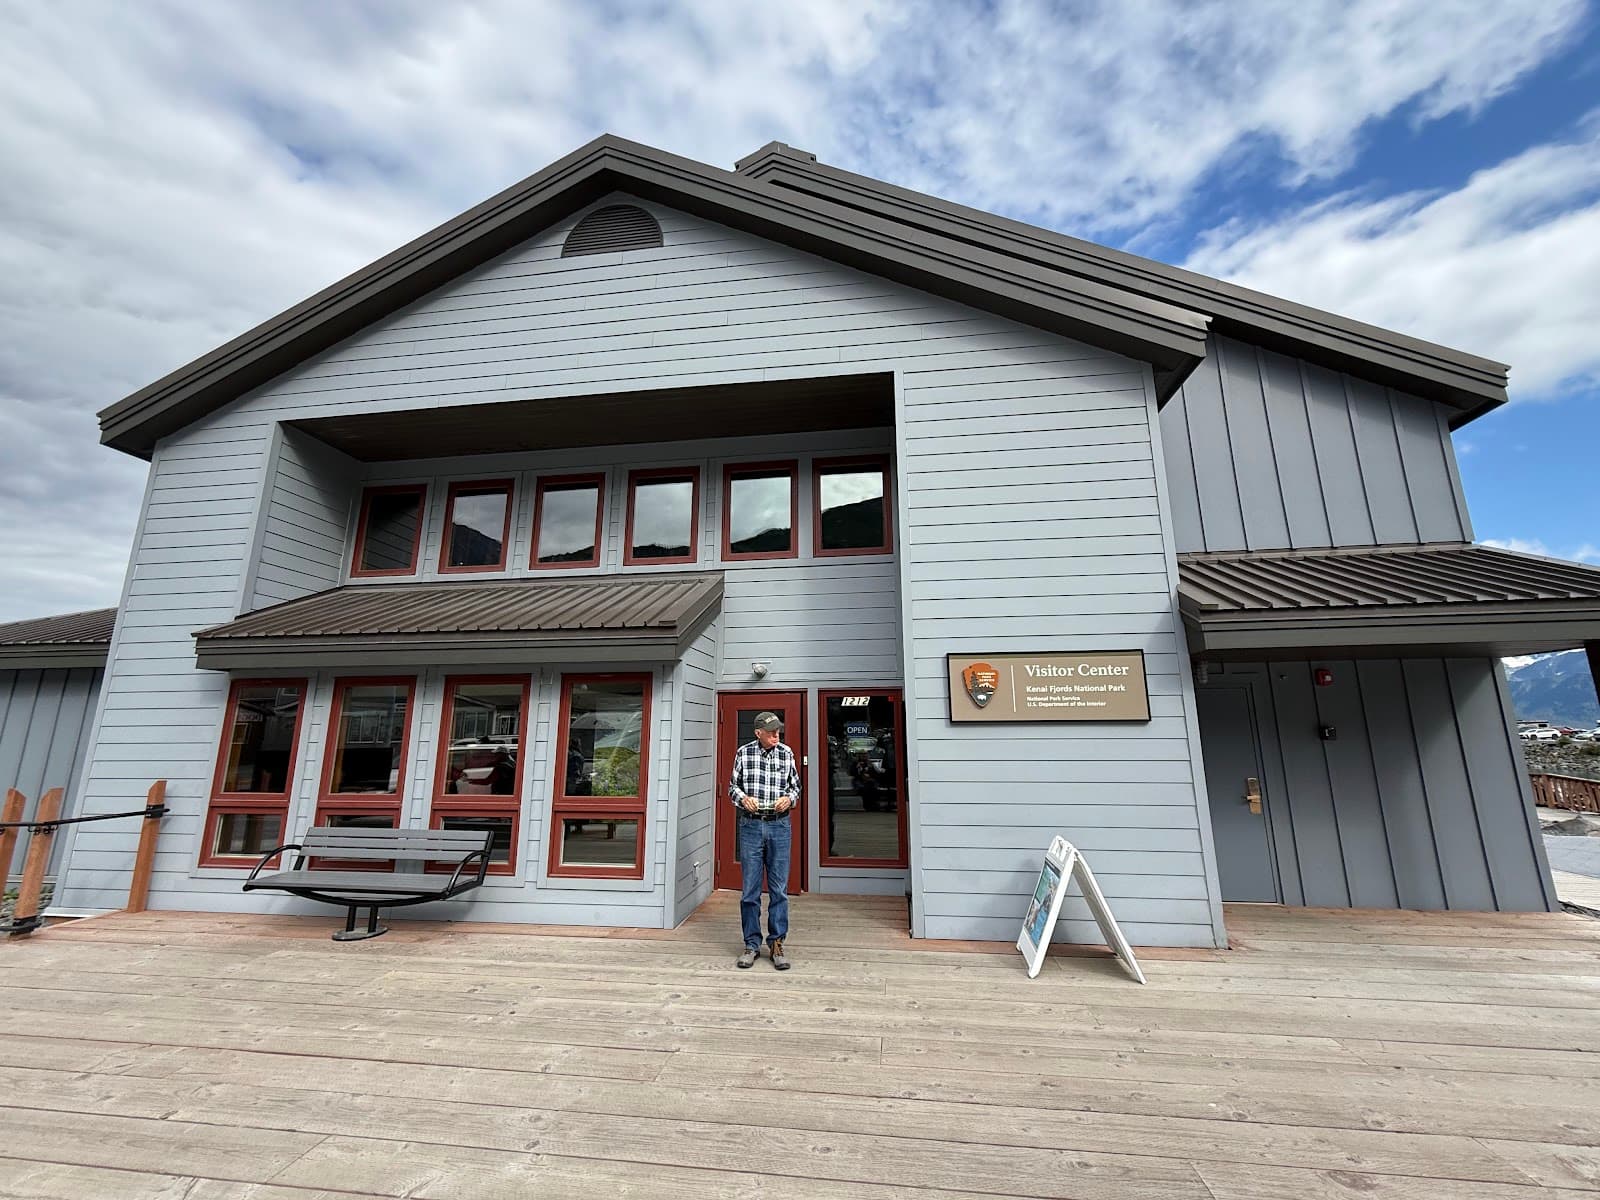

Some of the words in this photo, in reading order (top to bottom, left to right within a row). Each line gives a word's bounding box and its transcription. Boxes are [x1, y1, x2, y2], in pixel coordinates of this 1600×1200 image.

[1024, 665, 1074, 677] Visitor
[1078, 664, 1129, 676] Center
[1026, 685, 1048, 693] Kenai
[1050, 685, 1072, 693] Fjords
[1074, 684, 1106, 692] National
[1108, 684, 1126, 692] Park
[844, 697, 869, 705] 1212
[847, 726, 868, 734] OPEN
